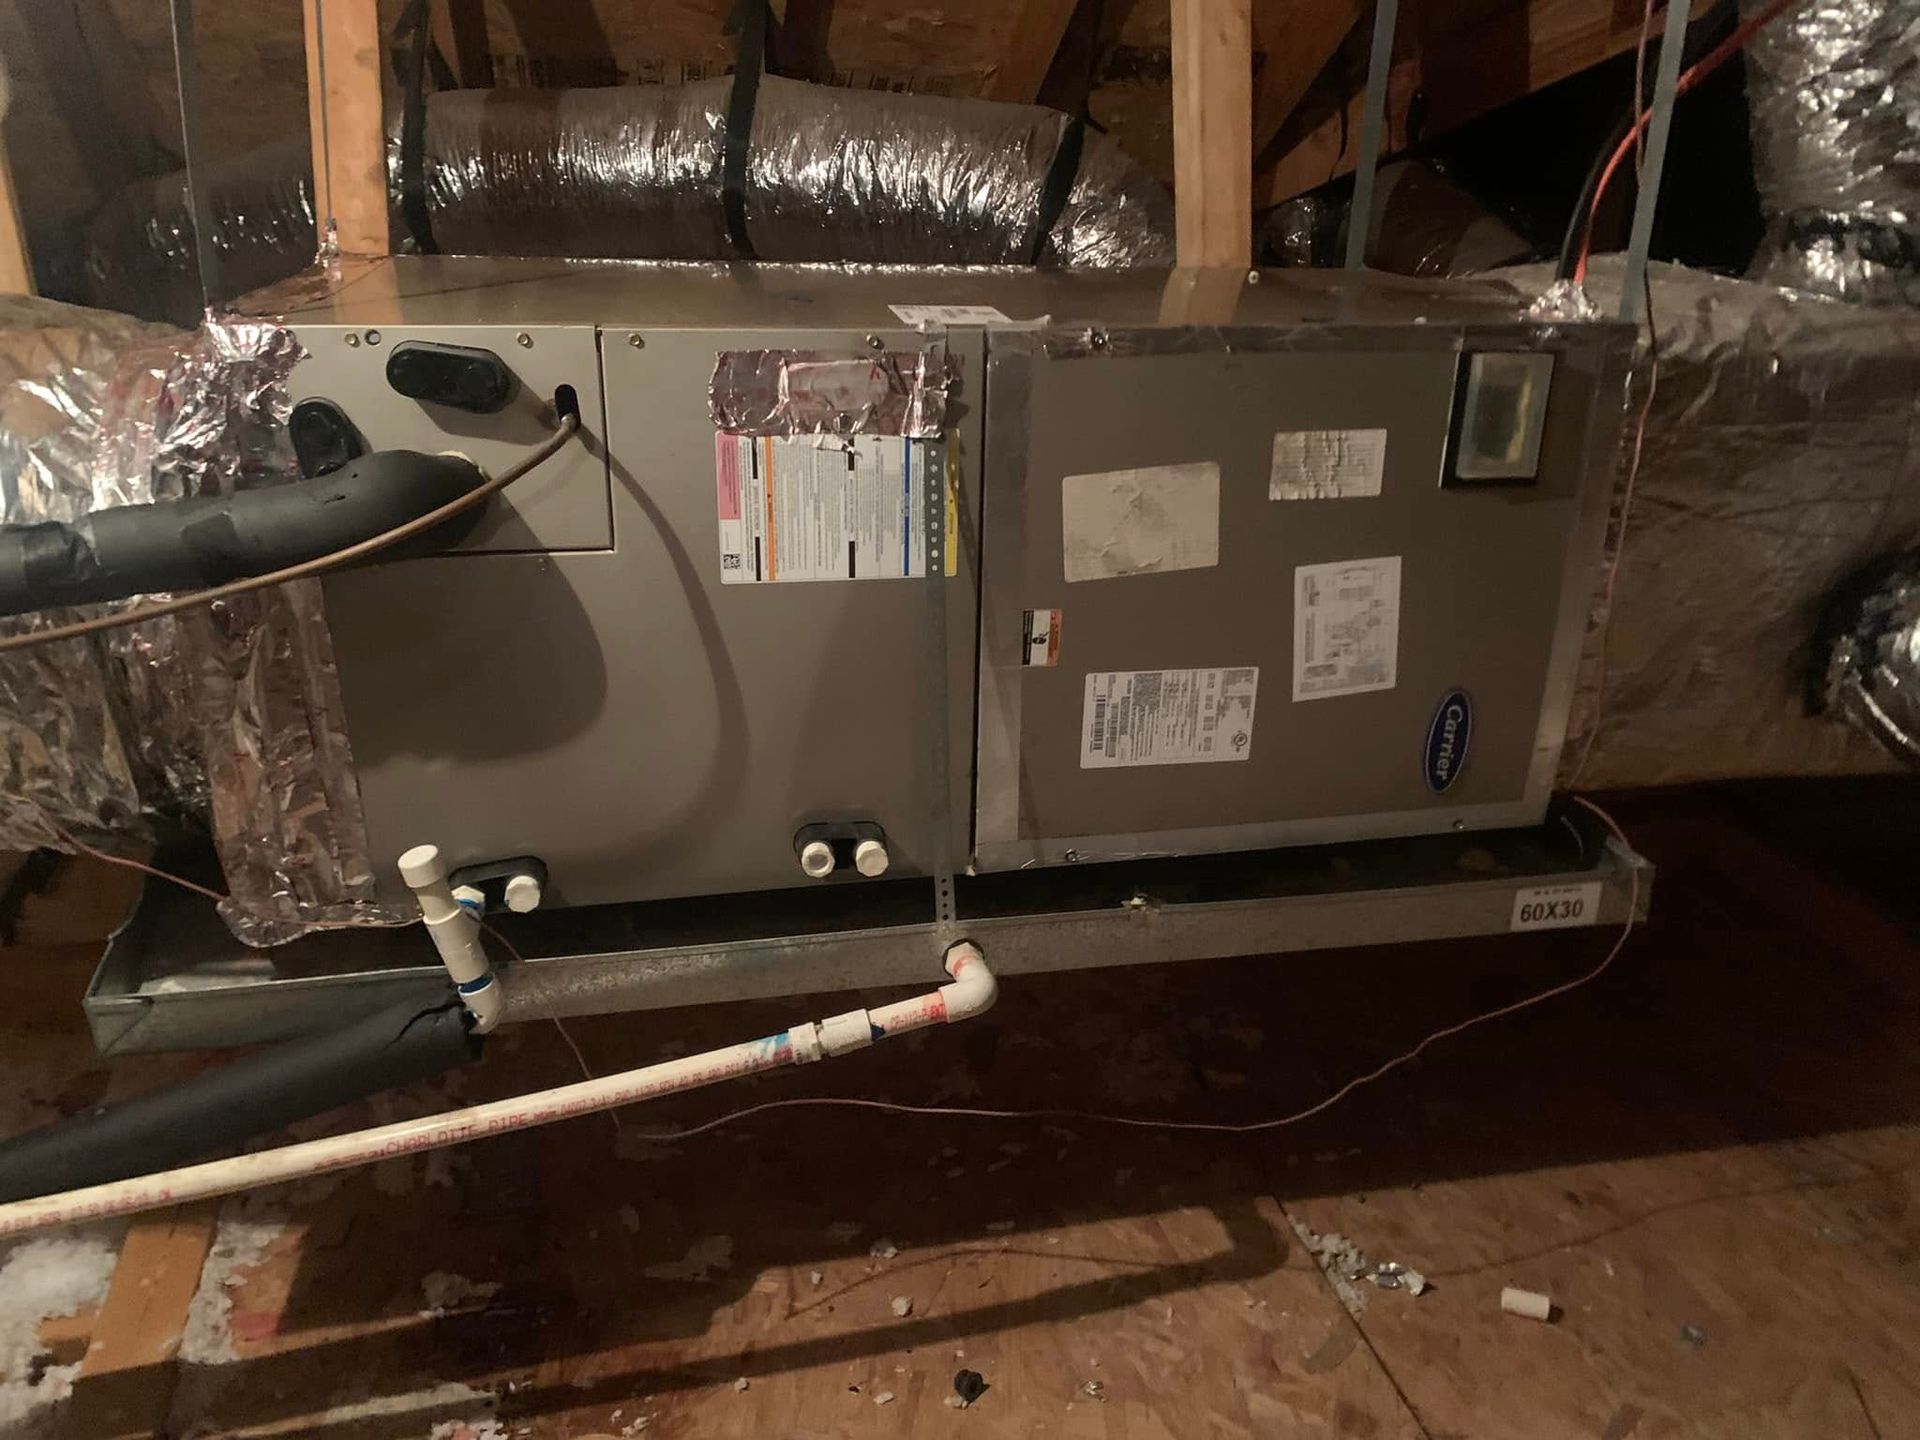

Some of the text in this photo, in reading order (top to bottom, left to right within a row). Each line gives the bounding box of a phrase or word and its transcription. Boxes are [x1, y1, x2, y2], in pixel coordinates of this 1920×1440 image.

[1436, 705, 1463, 781] Carrier
[1520, 899, 1584, 923] 60X30
[385, 1124, 481, 1154] CHARLOTTE
